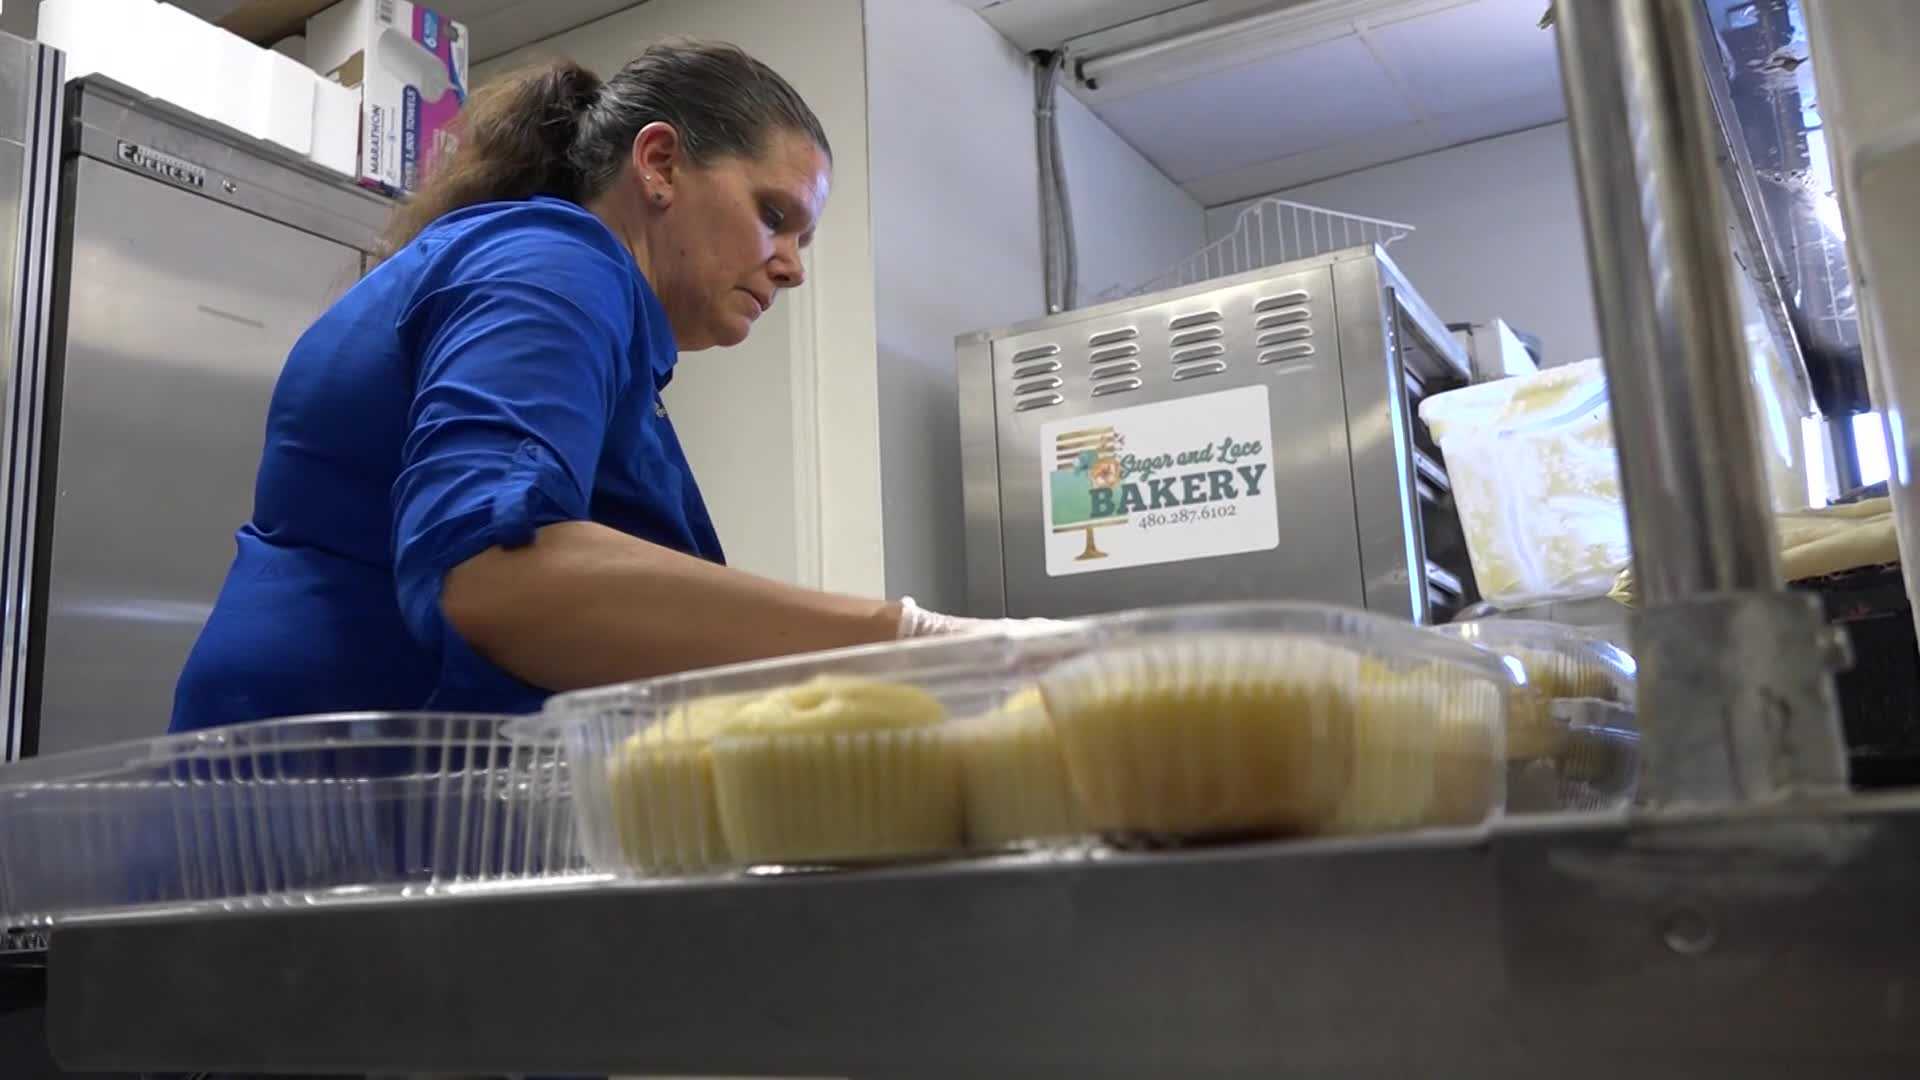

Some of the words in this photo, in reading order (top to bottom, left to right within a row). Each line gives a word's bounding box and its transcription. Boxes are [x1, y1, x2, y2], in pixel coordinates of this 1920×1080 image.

[405, 88, 417, 130] TOWELS
[369, 104, 381, 175] MARATHON
[1119, 453, 1174, 482] Sugar
[1176, 442, 1214, 466] and
[1217, 436, 1263, 464] Lace
[1089, 464, 1267, 518] BAKERY
[1138, 504, 1237, 530] 480.287.6102
